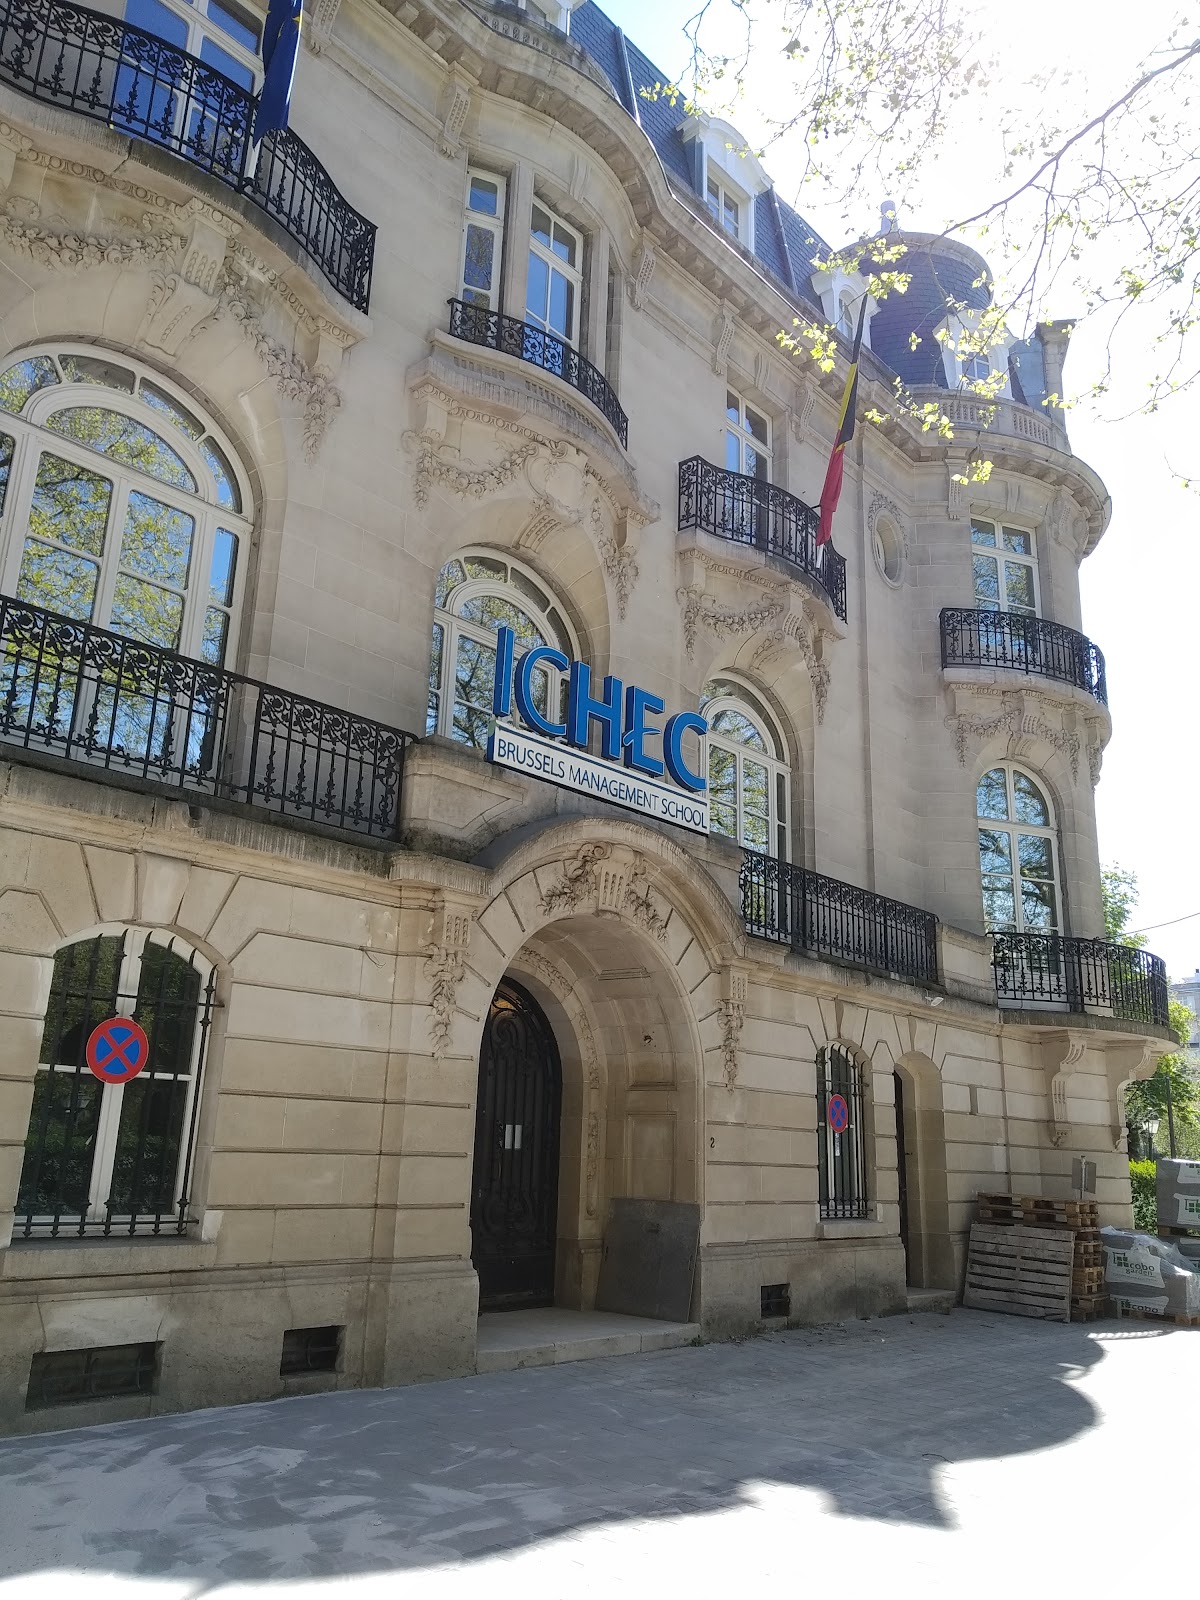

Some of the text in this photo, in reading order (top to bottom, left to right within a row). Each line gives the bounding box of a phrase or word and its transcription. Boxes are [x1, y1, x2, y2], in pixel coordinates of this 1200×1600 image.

[493, 627, 708, 792] ICHEC
[497, 738, 708, 829] BRUSSELS MANAGEMENT SCHOOL
[710, 1137, 715, 1148] 2
[1130, 1263, 1154, 1271] cobo
